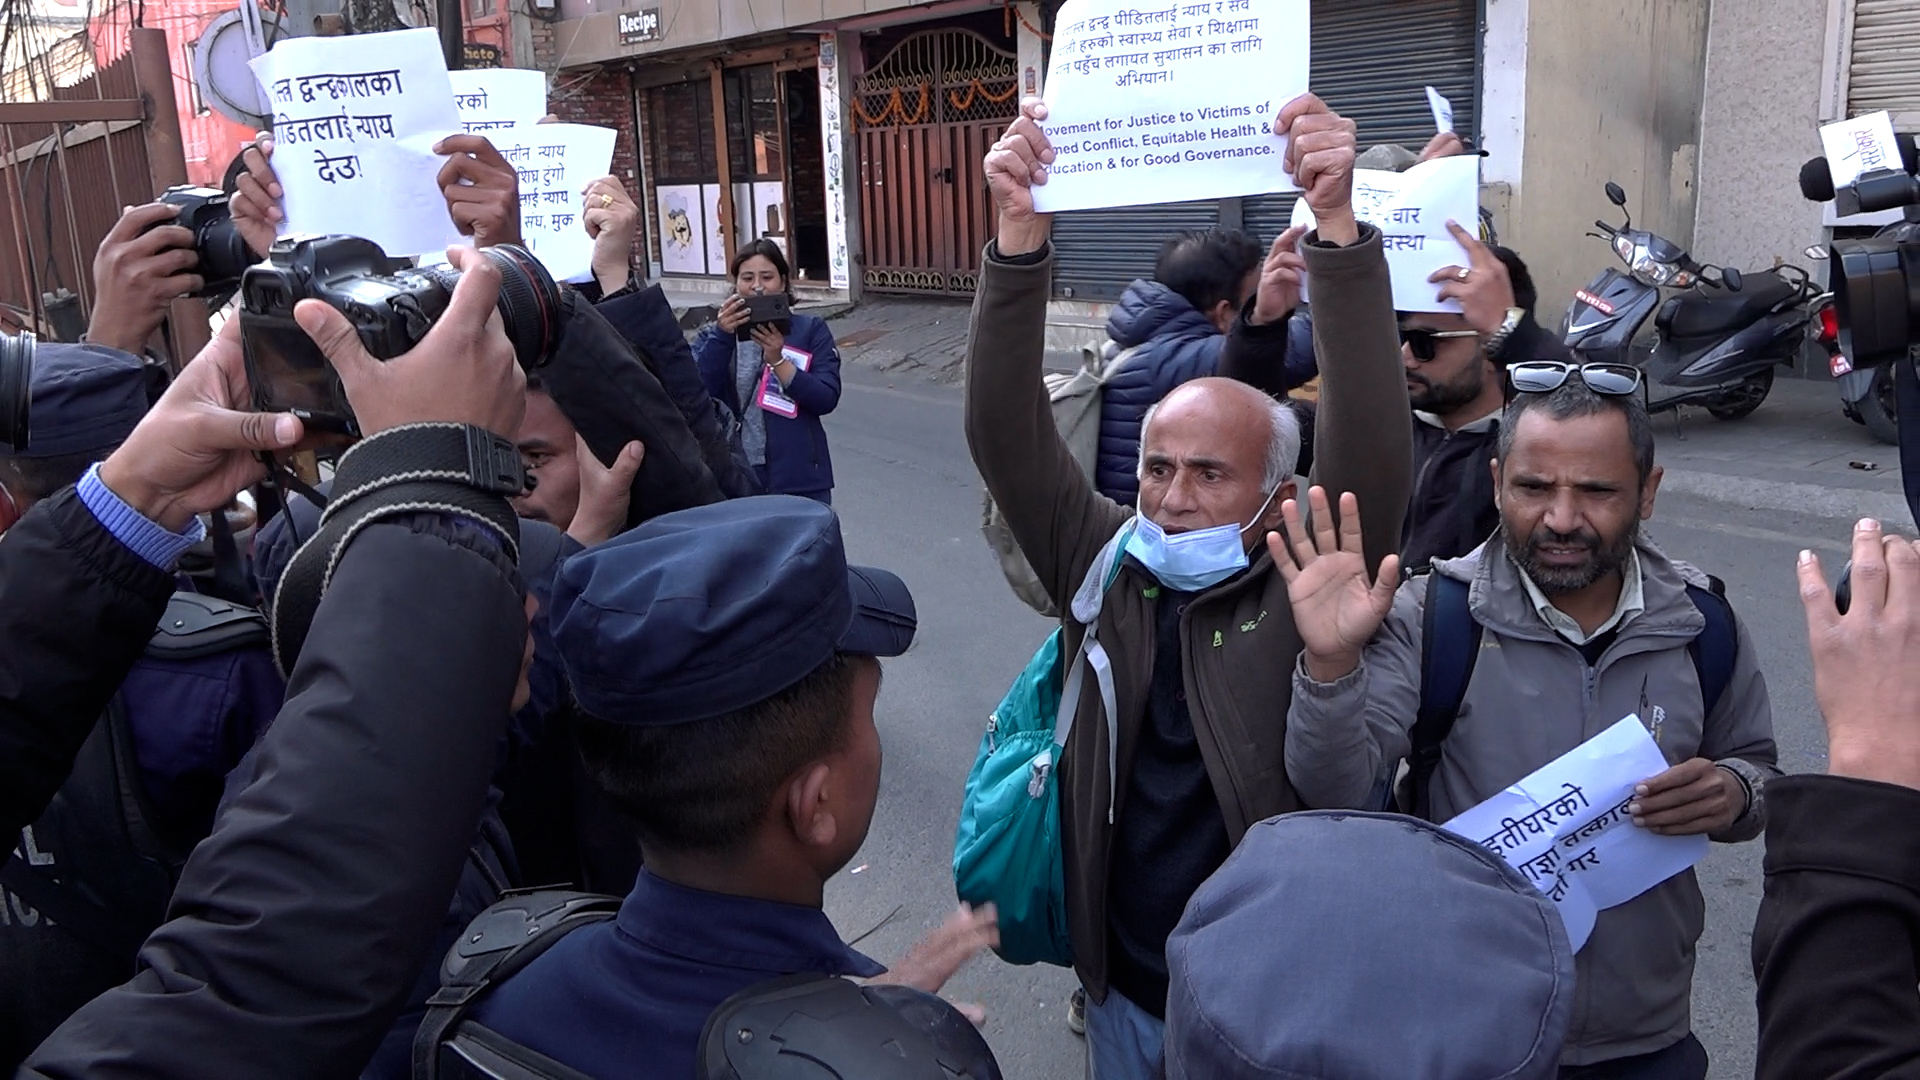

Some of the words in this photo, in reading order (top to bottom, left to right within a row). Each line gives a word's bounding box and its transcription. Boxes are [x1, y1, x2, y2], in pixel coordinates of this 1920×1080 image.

[1182, 3, 1211, 17] न्याय
[1216, 1, 1224, 14] र
[619, 10, 657, 34] Recipe
[1167, 24, 1192, 41] सेवा
[1196, 24, 1204, 37] र
[1207, 18, 1260, 36] शिक्षामा
[1104, 52, 1149, 68] लगायत
[1152, 45, 1203, 67] सुशासन
[1207, 42, 1227, 56] का
[1230, 35, 1263, 54] लागि
[455, 87, 488, 110] रको
[352, 114, 395, 139] न्याय
[1041, 120, 1101, 136] ovement
[1104, 118, 1124, 131] for
[1127, 113, 1176, 129] Justice
[1180, 111, 1194, 123] to
[1197, 105, 1251, 121] Victims
[1255, 100, 1271, 114] of
[1053, 143, 1079, 156] med
[1082, 136, 1138, 153] Conflict,
[1142, 131, 1207, 147] Equitable
[1210, 124, 1257, 140] Health
[1261, 122, 1272, 135] &
[538, 145, 566, 158] न्याय
[1044, 160, 1103, 176] ducation
[1107, 157, 1117, 170] &
[1120, 156, 1141, 169] for
[1143, 152, 1181, 167] Good
[1184, 145, 1276, 163] Governance.
[314, 149, 363, 184] देउ!
[542, 190, 569, 205] न्याय
[1383, 235, 1426, 250] वस्था
[1480, 783, 1590, 859] इतीघरको
[1567, 847, 1600, 871] गर
